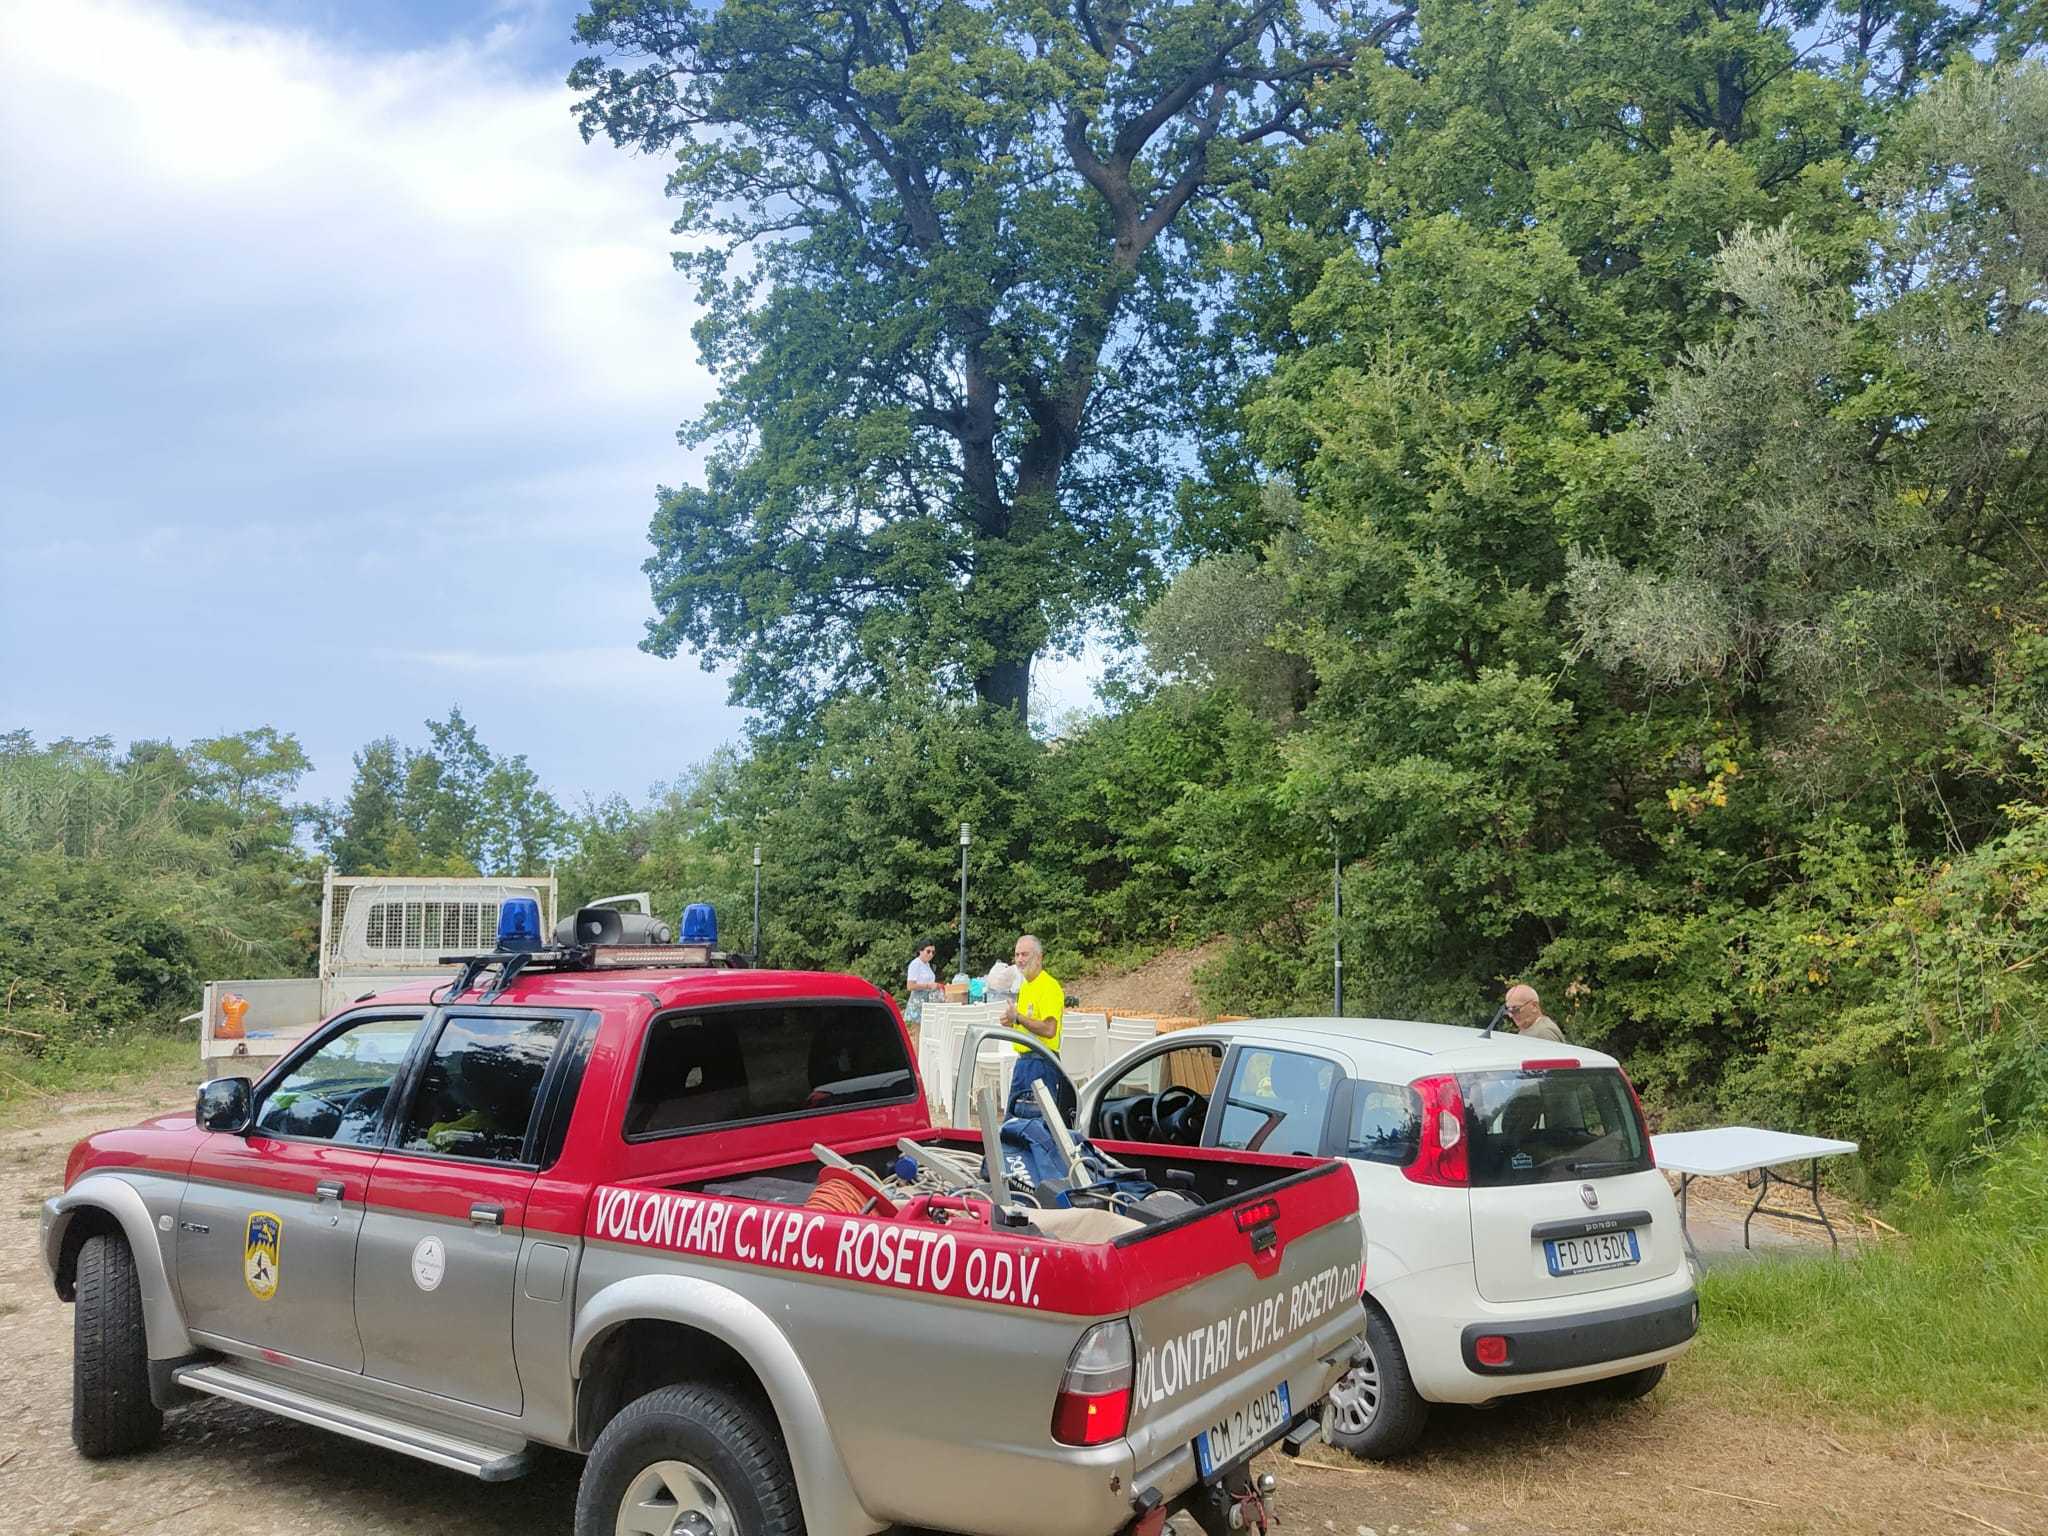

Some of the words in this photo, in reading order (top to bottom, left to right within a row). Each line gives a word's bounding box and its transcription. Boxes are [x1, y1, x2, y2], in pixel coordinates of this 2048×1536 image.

[596, 1188, 733, 1254] VOLONTARI
[735, 1206, 825, 1270] C.V.P.C.
[835, 1219, 957, 1292] ROSETO
[965, 1248, 1040, 1306] O.D.V.
[1557, 1240, 1579, 1268] FD
[1583, 1233, 1630, 1263] 013DK
[1134, 1316, 1232, 1416] VOLONTARI
[1235, 1292, 1284, 1362] C.V.P.C.
[1288, 1265, 1338, 1332] ROSETO
[1210, 1418, 1233, 1463] CM
[1234, 1389, 1281, 1446] 249WB
